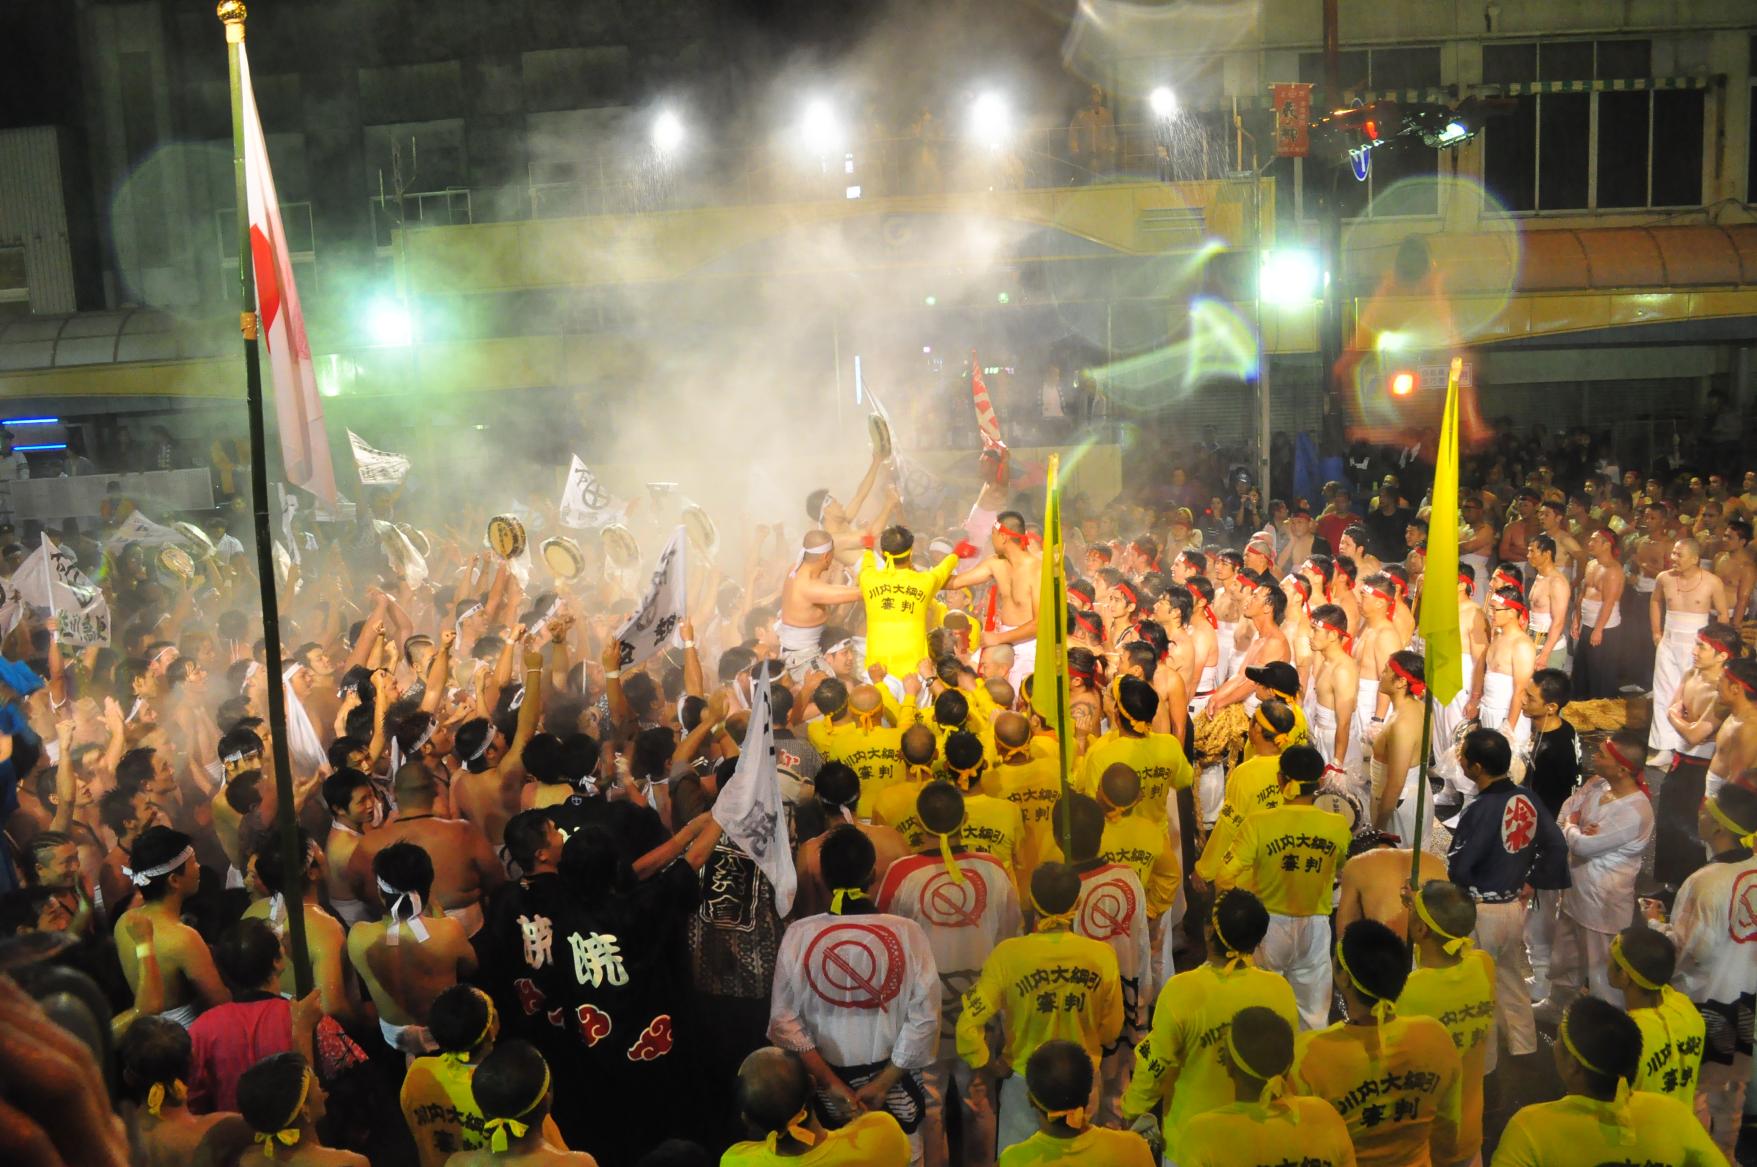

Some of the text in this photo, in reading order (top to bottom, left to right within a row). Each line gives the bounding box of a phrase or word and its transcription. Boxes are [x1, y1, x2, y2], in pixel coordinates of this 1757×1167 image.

[869, 584, 926, 604] 川内大綱引
[881, 597, 915, 614] 審判
[858, 765, 894, 779] 審判
[1266, 833, 1337, 857] 川内大綱引
[1281, 854, 1323, 873] 審判
[1016, 965, 1102, 997] 川内大綱引
[1037, 992, 1087, 1014] 審判
[1338, 1071, 1441, 1116] 川内大綱引
[1360, 1097, 1421, 1128] 審判
